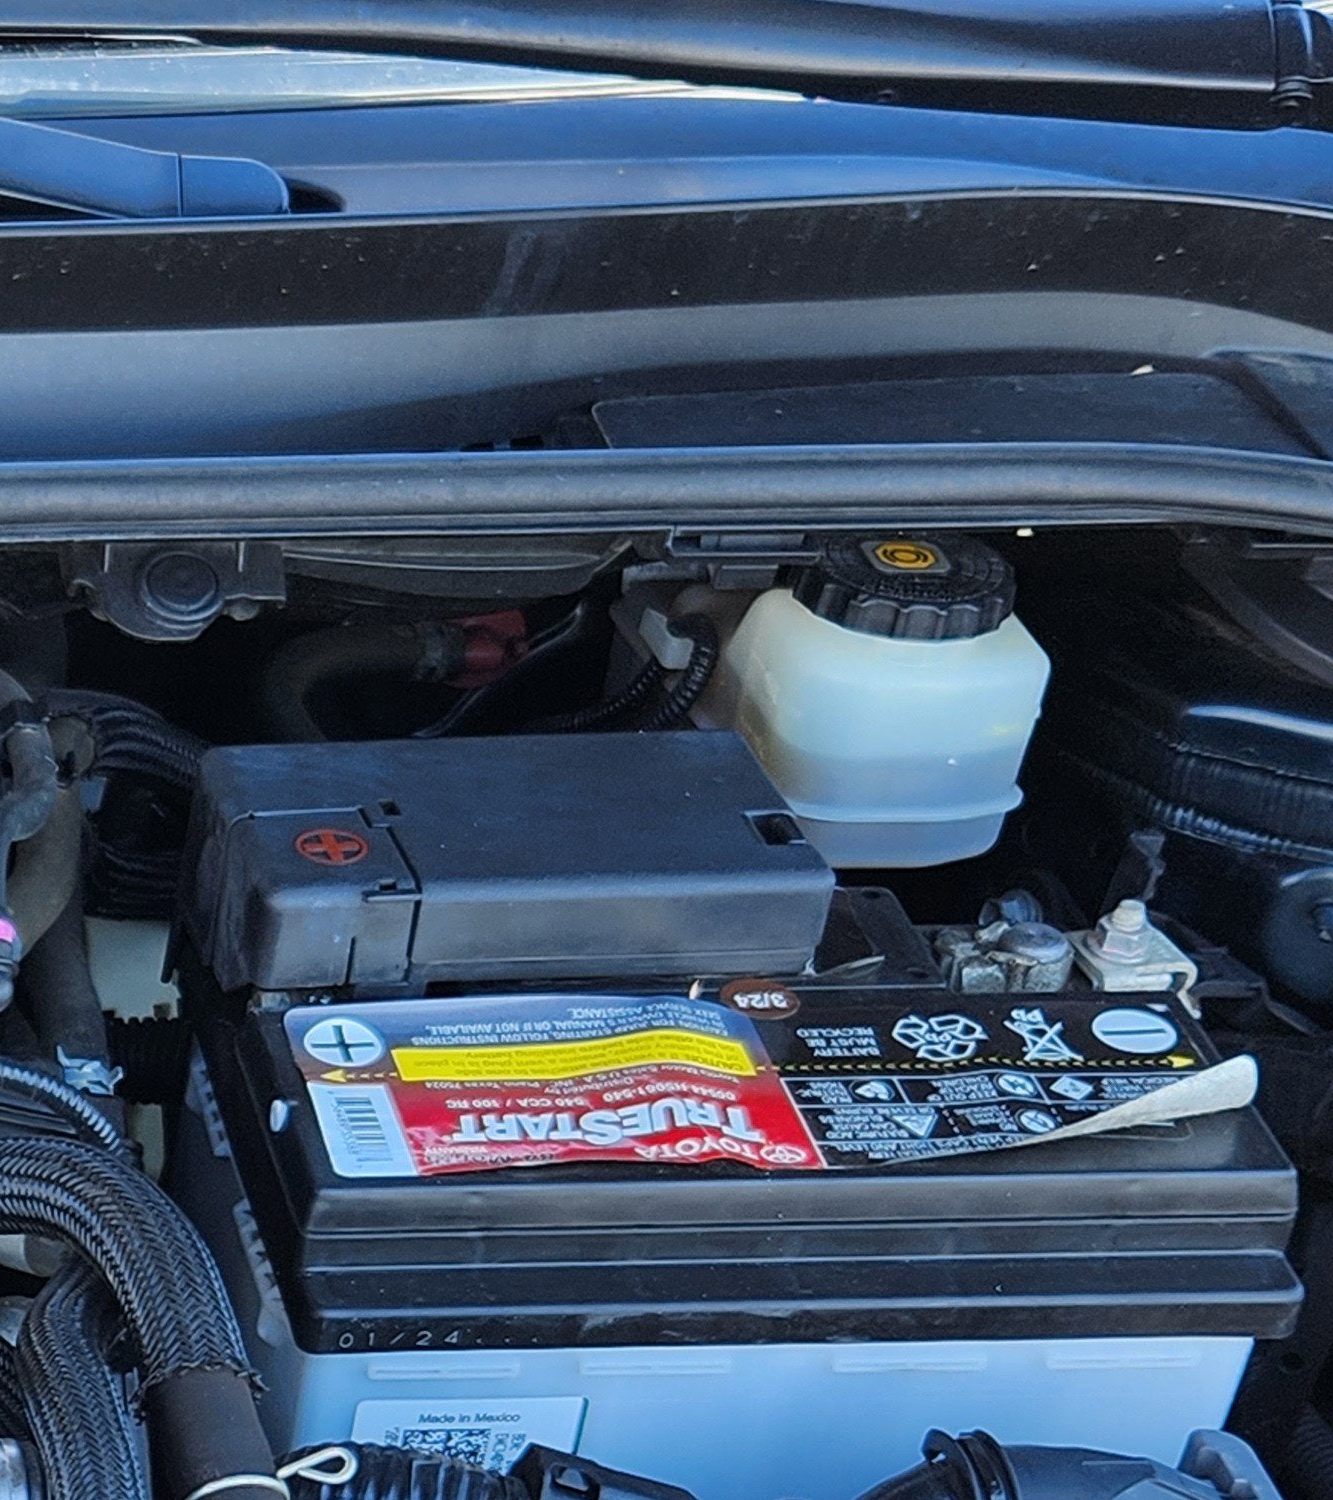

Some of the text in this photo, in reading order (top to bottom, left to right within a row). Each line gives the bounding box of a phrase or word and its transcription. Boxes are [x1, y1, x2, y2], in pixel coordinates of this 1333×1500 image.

[733, 991, 789, 1010] 3/24
[495, 1021, 520, 1034] NOT
[795, 1026, 874, 1039] RECYCLED
[805, 1037, 876, 1048] MUST BE
[813, 1047, 881, 1058] BATTERY
[516, 1098, 553, 1108] CCA
[633, 1136, 760, 1161] TOYOTA
[418, 1411, 522, 1424] Made in Mexico
